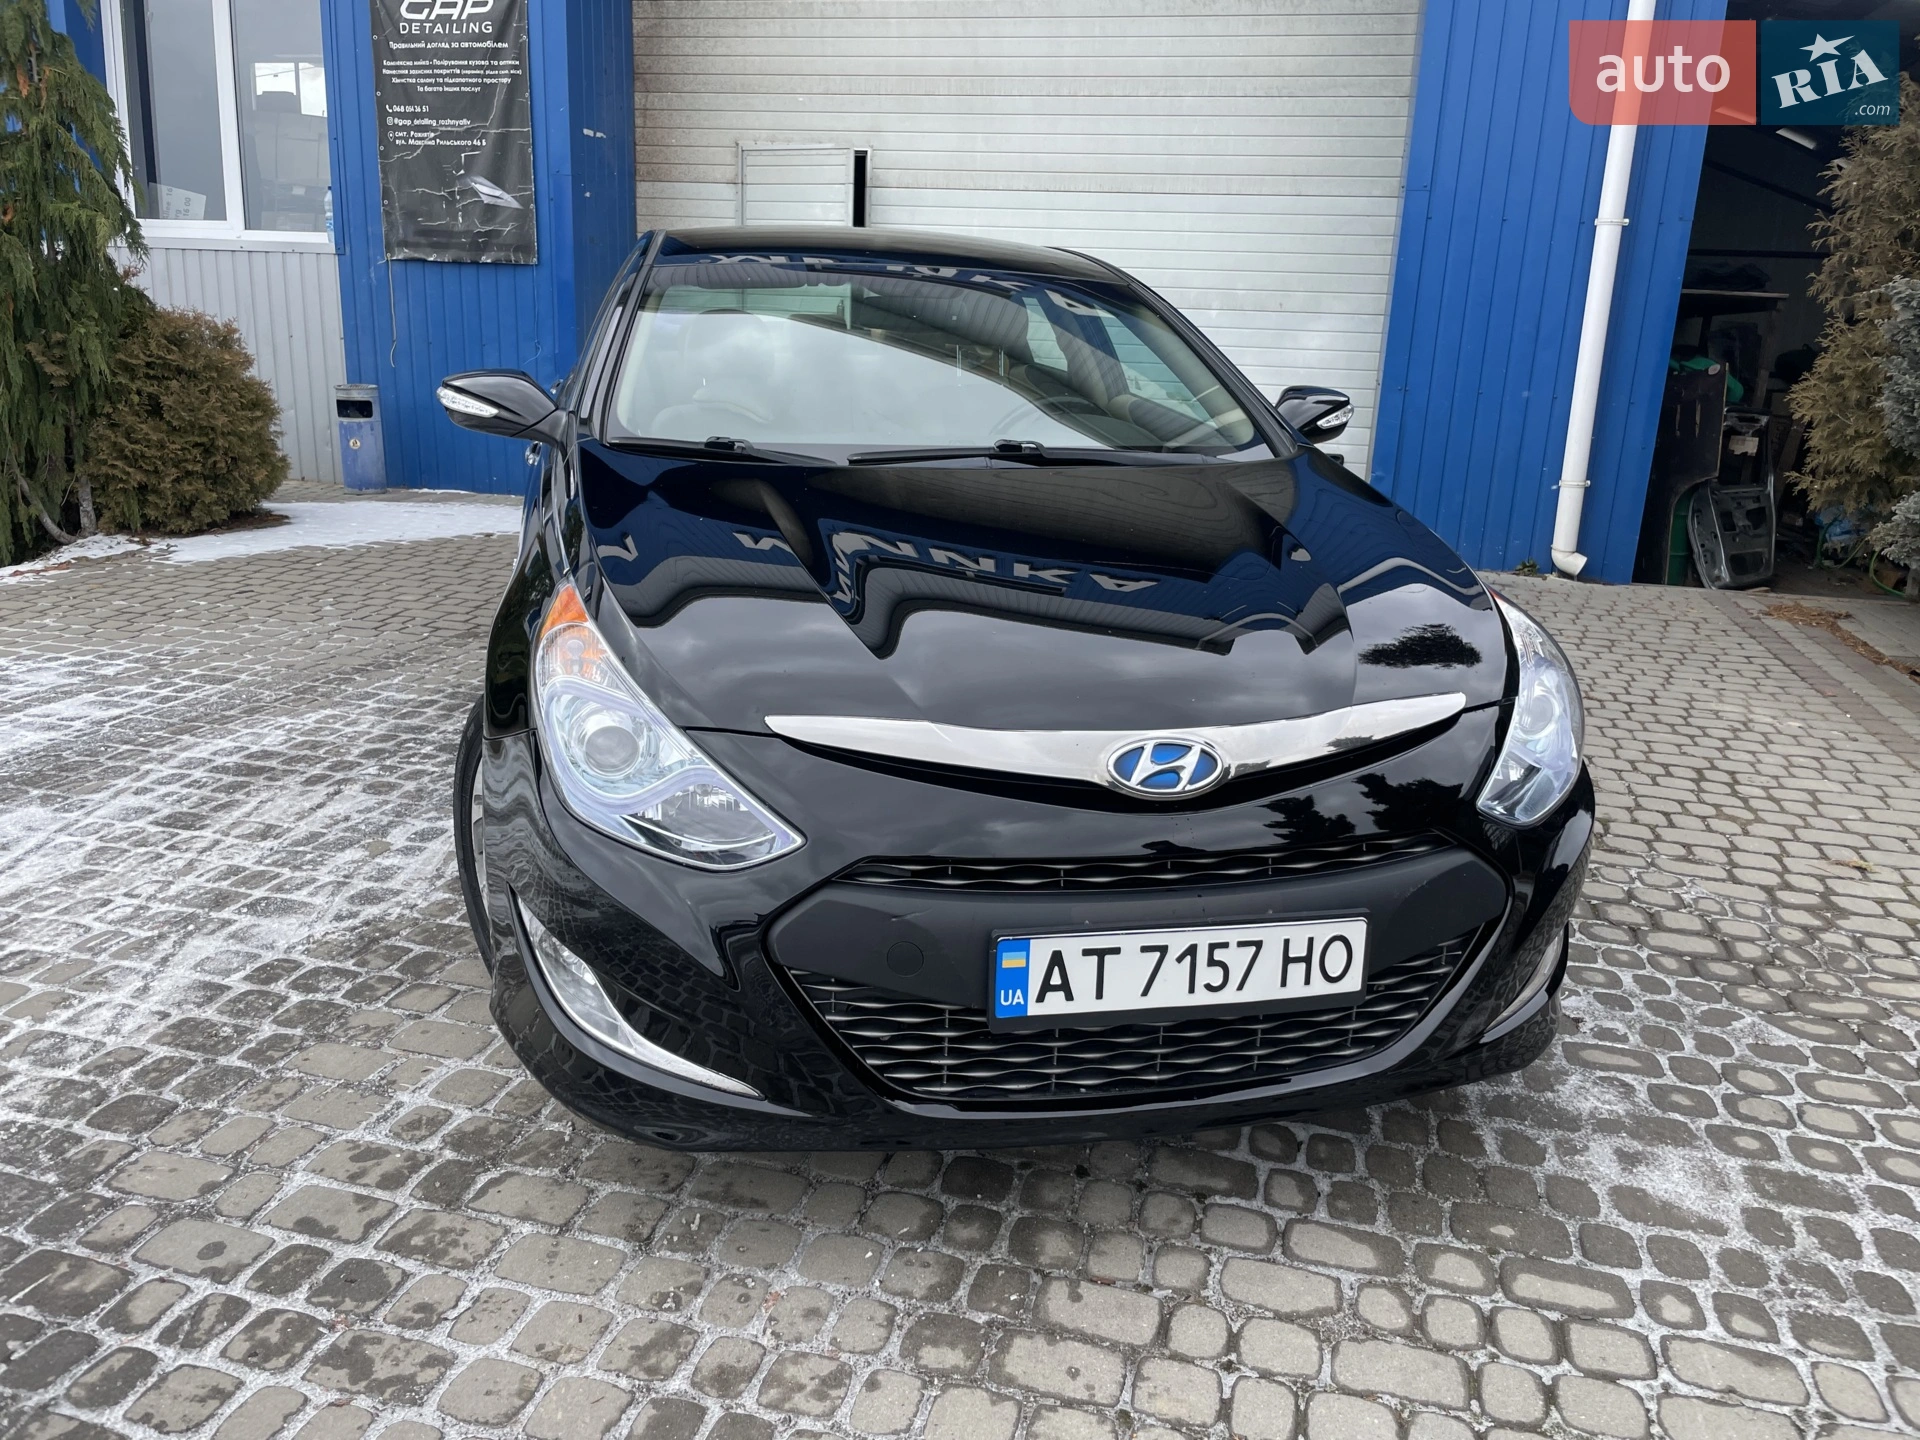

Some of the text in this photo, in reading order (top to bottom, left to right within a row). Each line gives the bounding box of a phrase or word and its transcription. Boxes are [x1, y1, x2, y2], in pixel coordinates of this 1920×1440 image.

[400, 0, 494, 20] GAP
[399, 22, 493, 34] DETAILING
[460, 40, 509, 49] автомобілем
[1035, 934, 1353, 1003] AT 7157 HO
[1000, 988, 1025, 1006] UA
